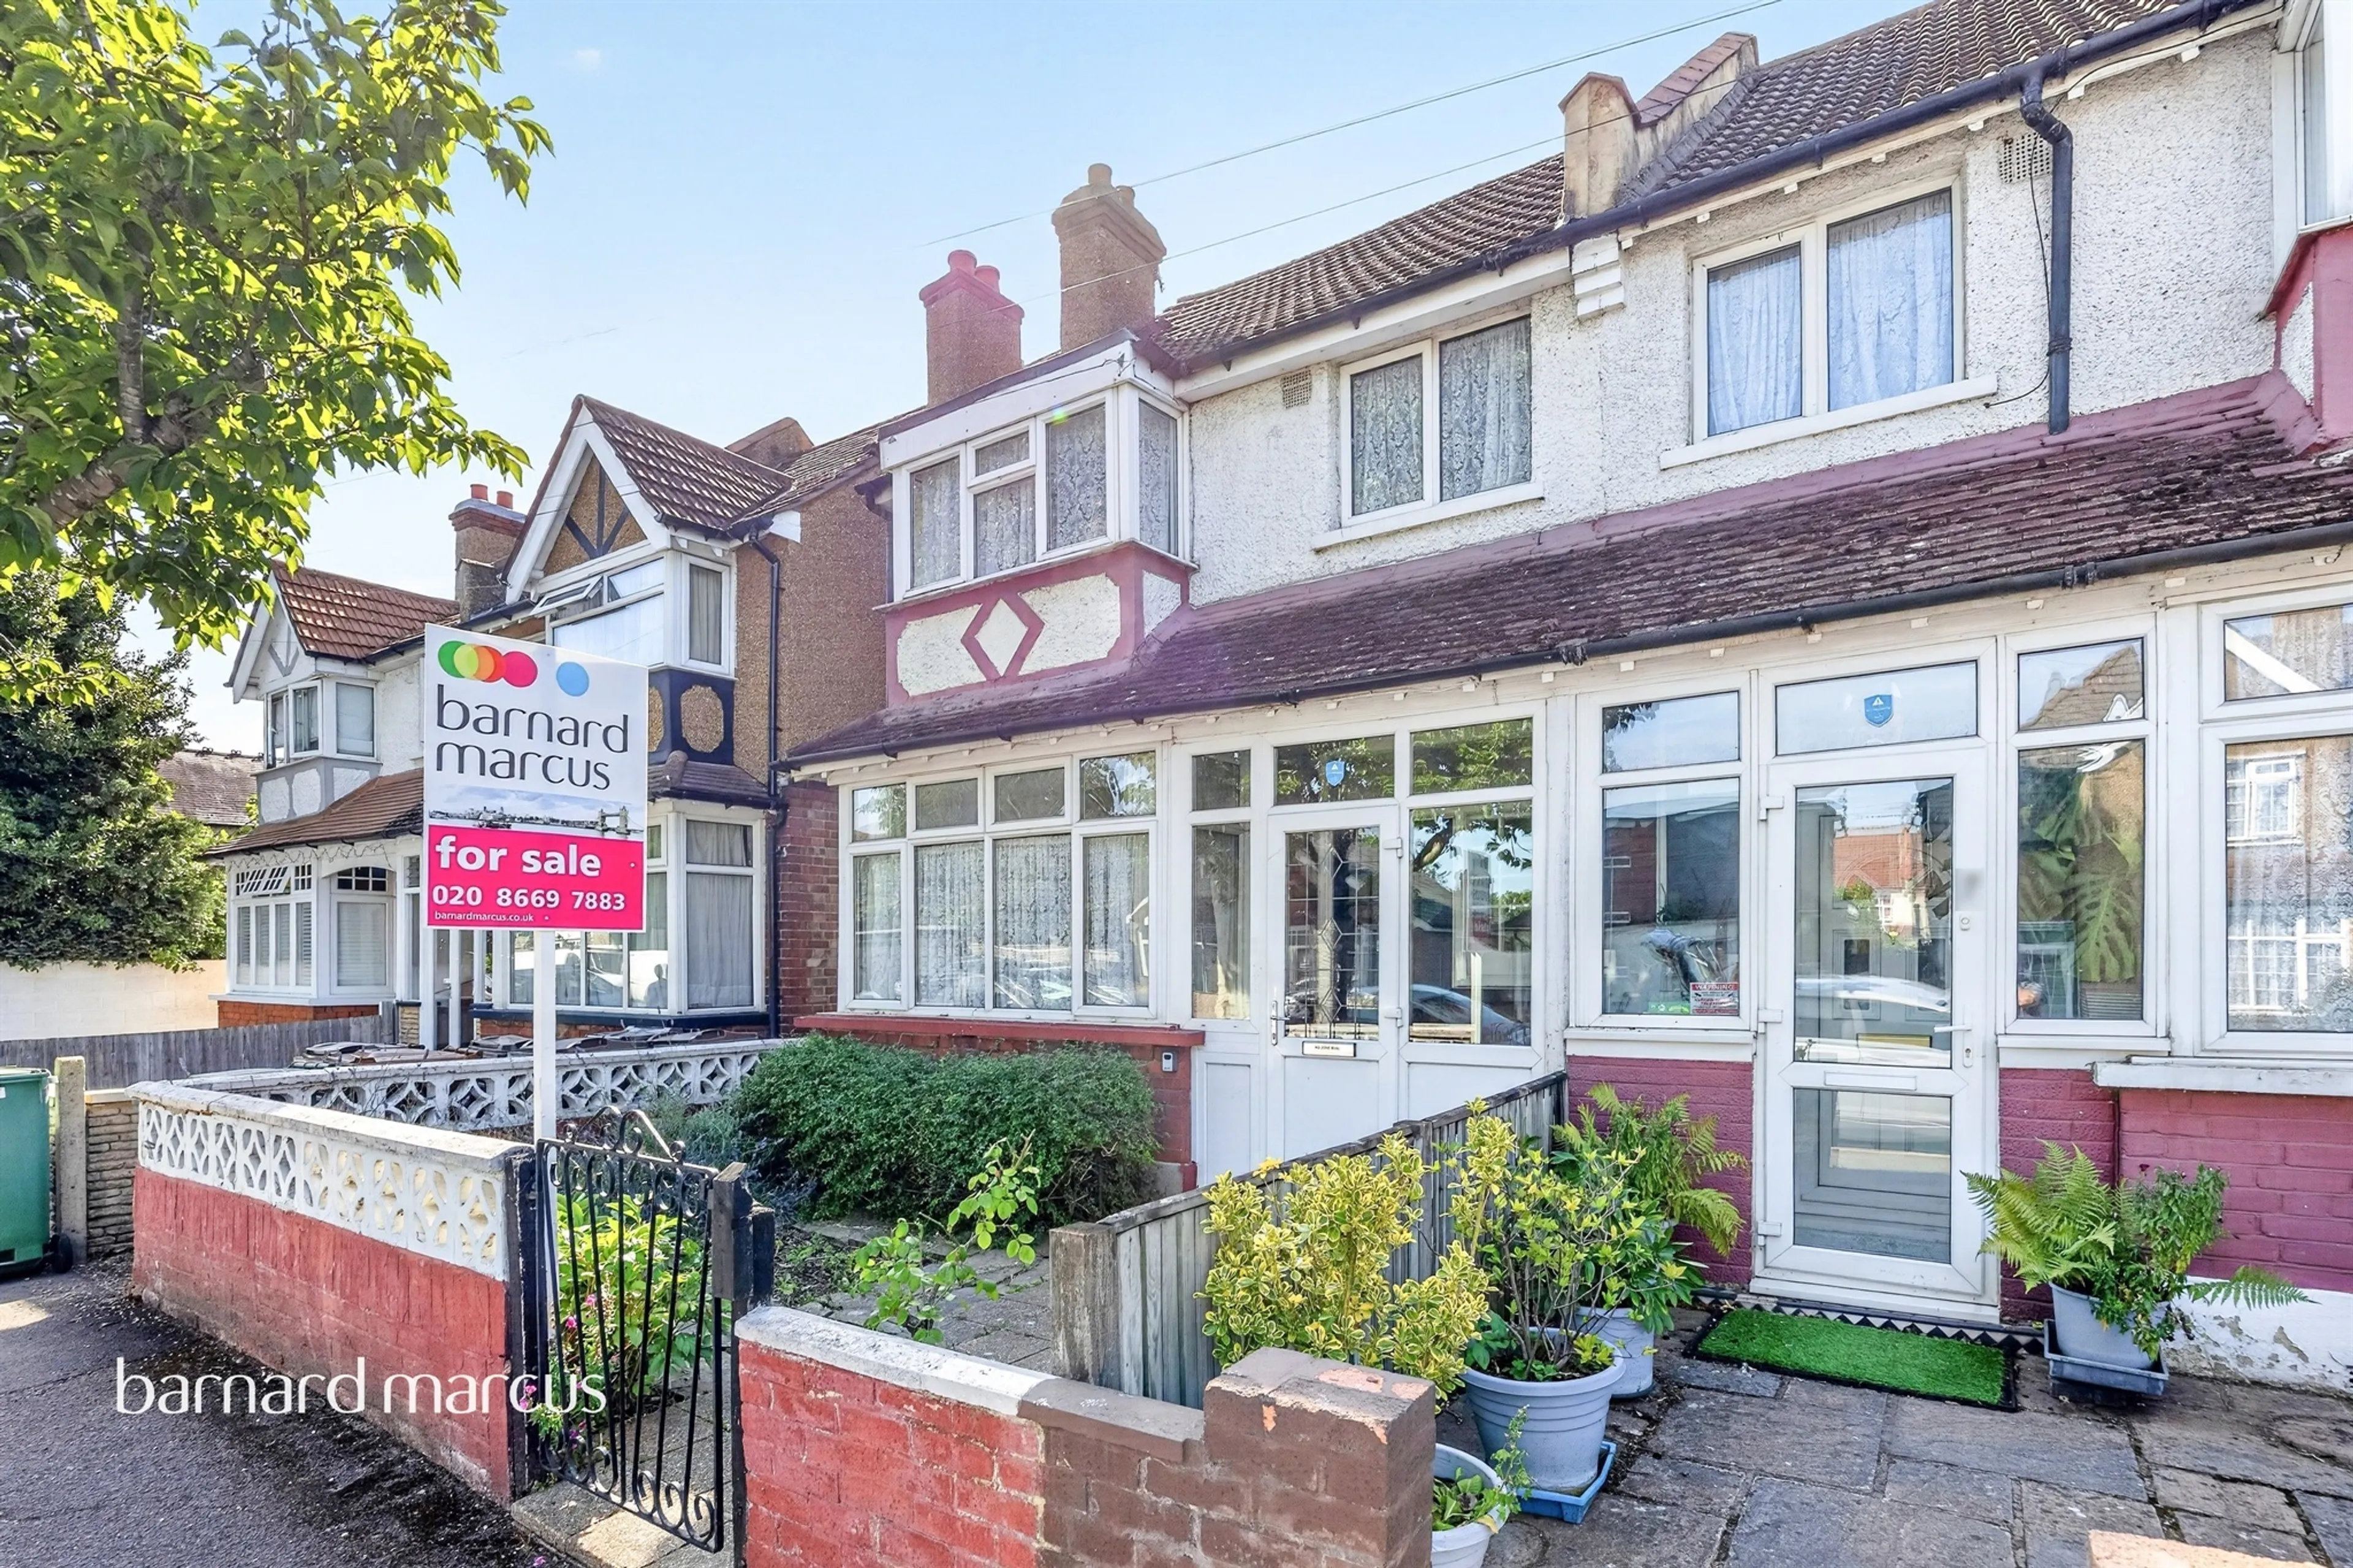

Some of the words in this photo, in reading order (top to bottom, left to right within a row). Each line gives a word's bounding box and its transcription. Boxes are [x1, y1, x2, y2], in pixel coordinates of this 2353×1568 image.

[436, 684, 629, 754] barnard
[436, 741, 610, 790] marcus
[435, 835, 508, 871] for
[521, 844, 602, 877] sale
[432, 885, 482, 906] 020
[496, 887, 560, 909] 8669
[571, 891, 626, 911] 7883
[434, 911, 534, 922] barnardmarcus.co.uk
